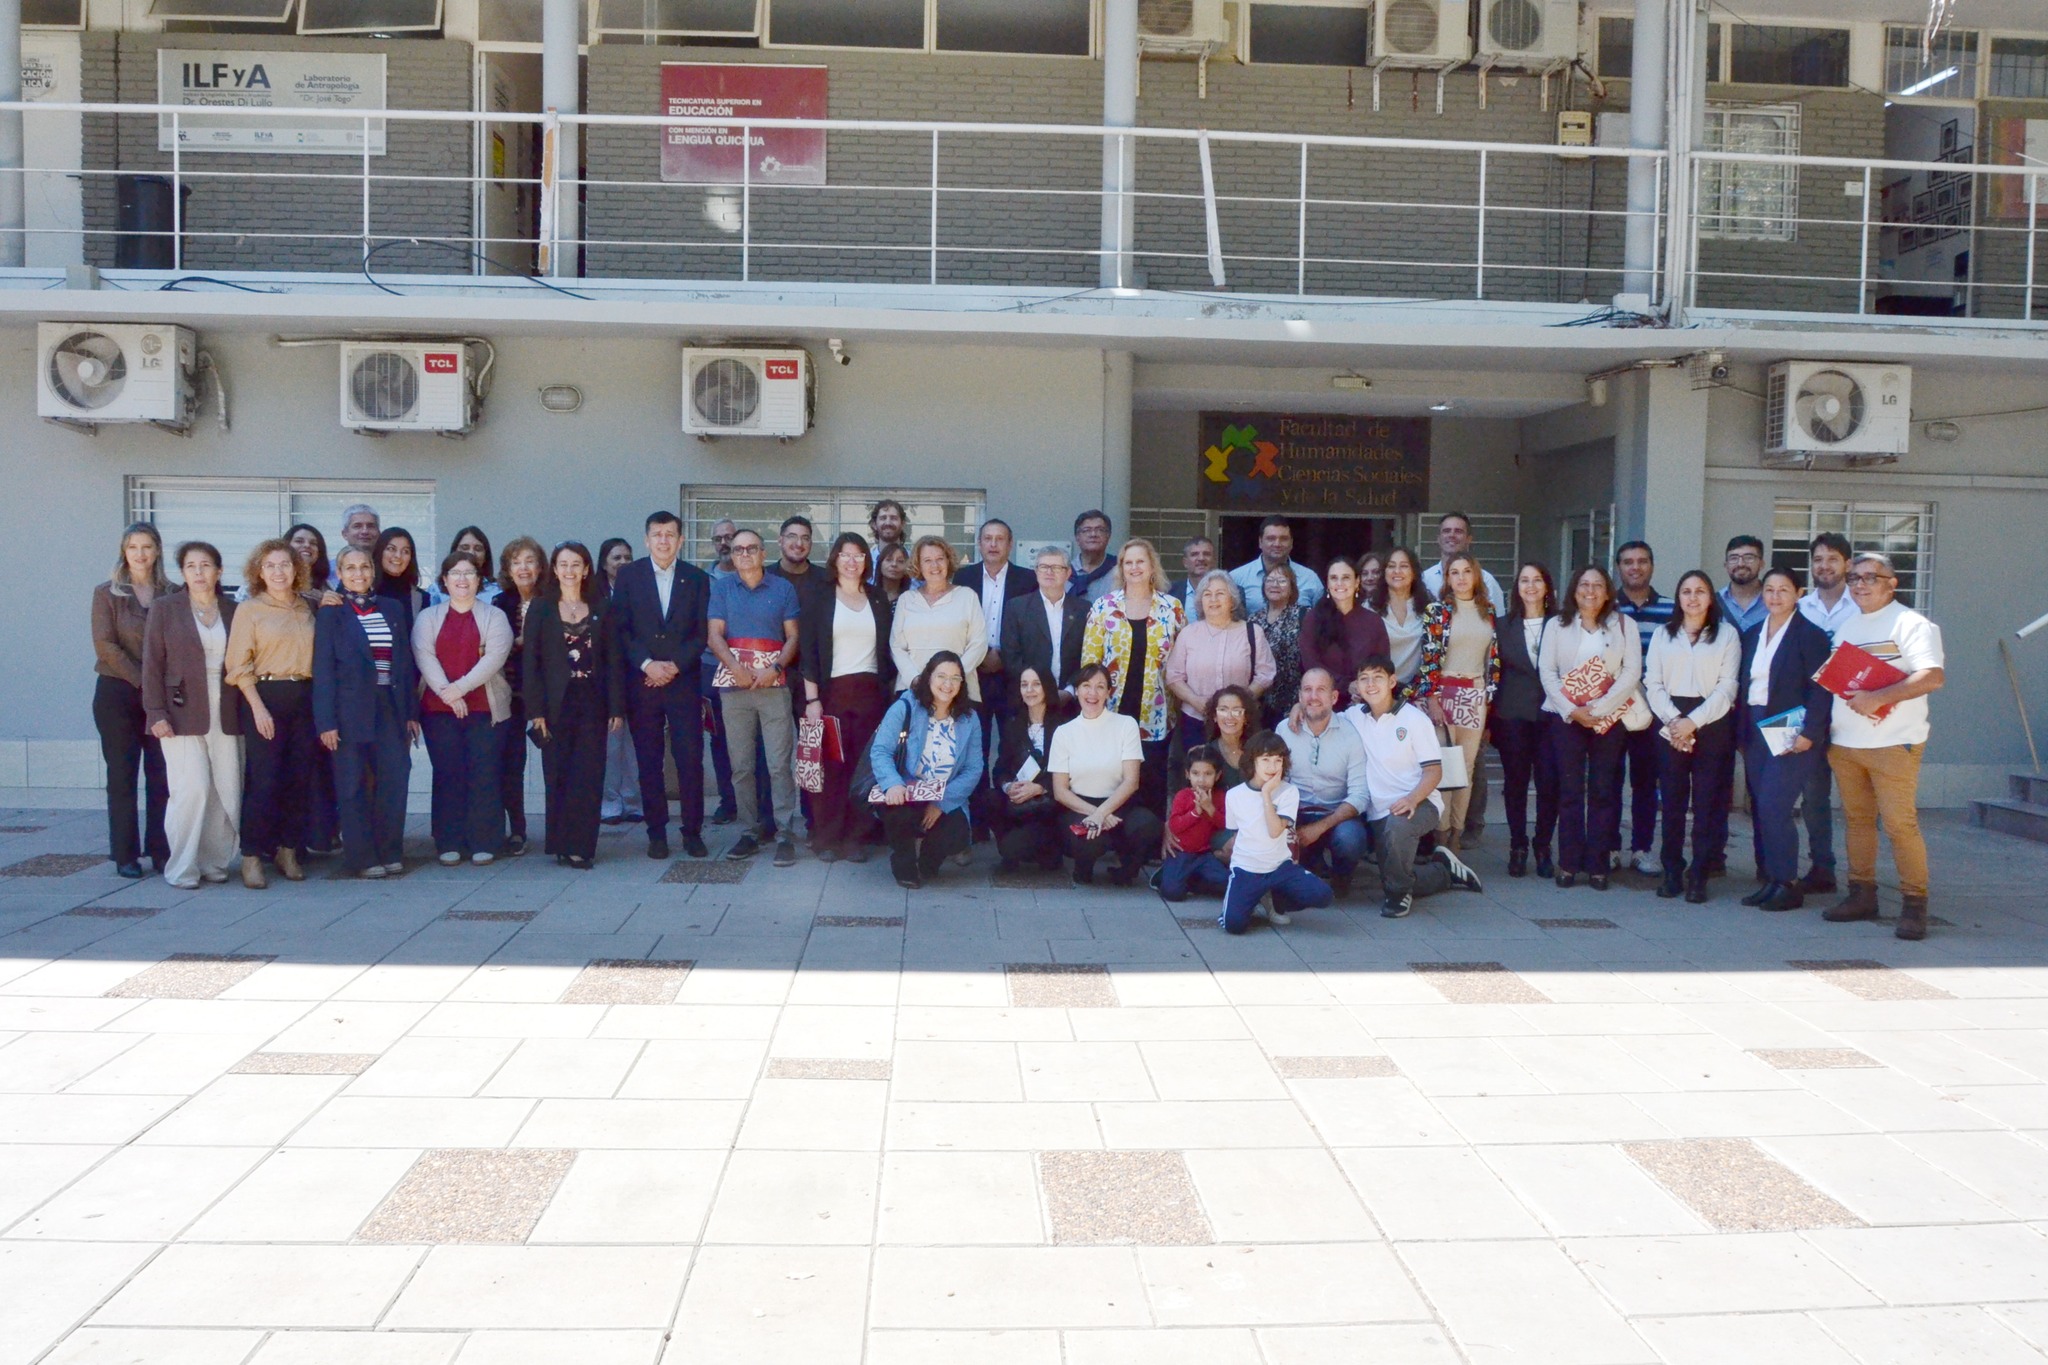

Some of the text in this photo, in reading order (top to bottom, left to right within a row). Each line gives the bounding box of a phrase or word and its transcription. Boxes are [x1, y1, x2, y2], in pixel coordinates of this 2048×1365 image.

[303, 74, 352, 82] Laboratorio
[307, 81, 360, 91] Antropología
[183, 97, 273, 107] Dr. Orestes Di Lullo
[716, 98, 751, 106] SUPERIOR
[668, 105, 734, 116] EDUCACIÓN
[685, 126, 717, 134] MENCIÓN
[718, 127, 729, 135] EN
[668, 135, 713, 145] LENGUA
[142, 357, 163, 369] LG
[428, 359, 454, 368] TCL
[769, 365, 795, 375] TCL
[1882, 394, 1897, 406] LG
[1279, 418, 1391, 438] Facultad de
[1279, 441, 1404, 461] Humanidades
[1277, 464, 1423, 484] Ciencias Sociales
[1322, 487, 1338, 504] la
[1344, 487, 1397, 506] Salud
